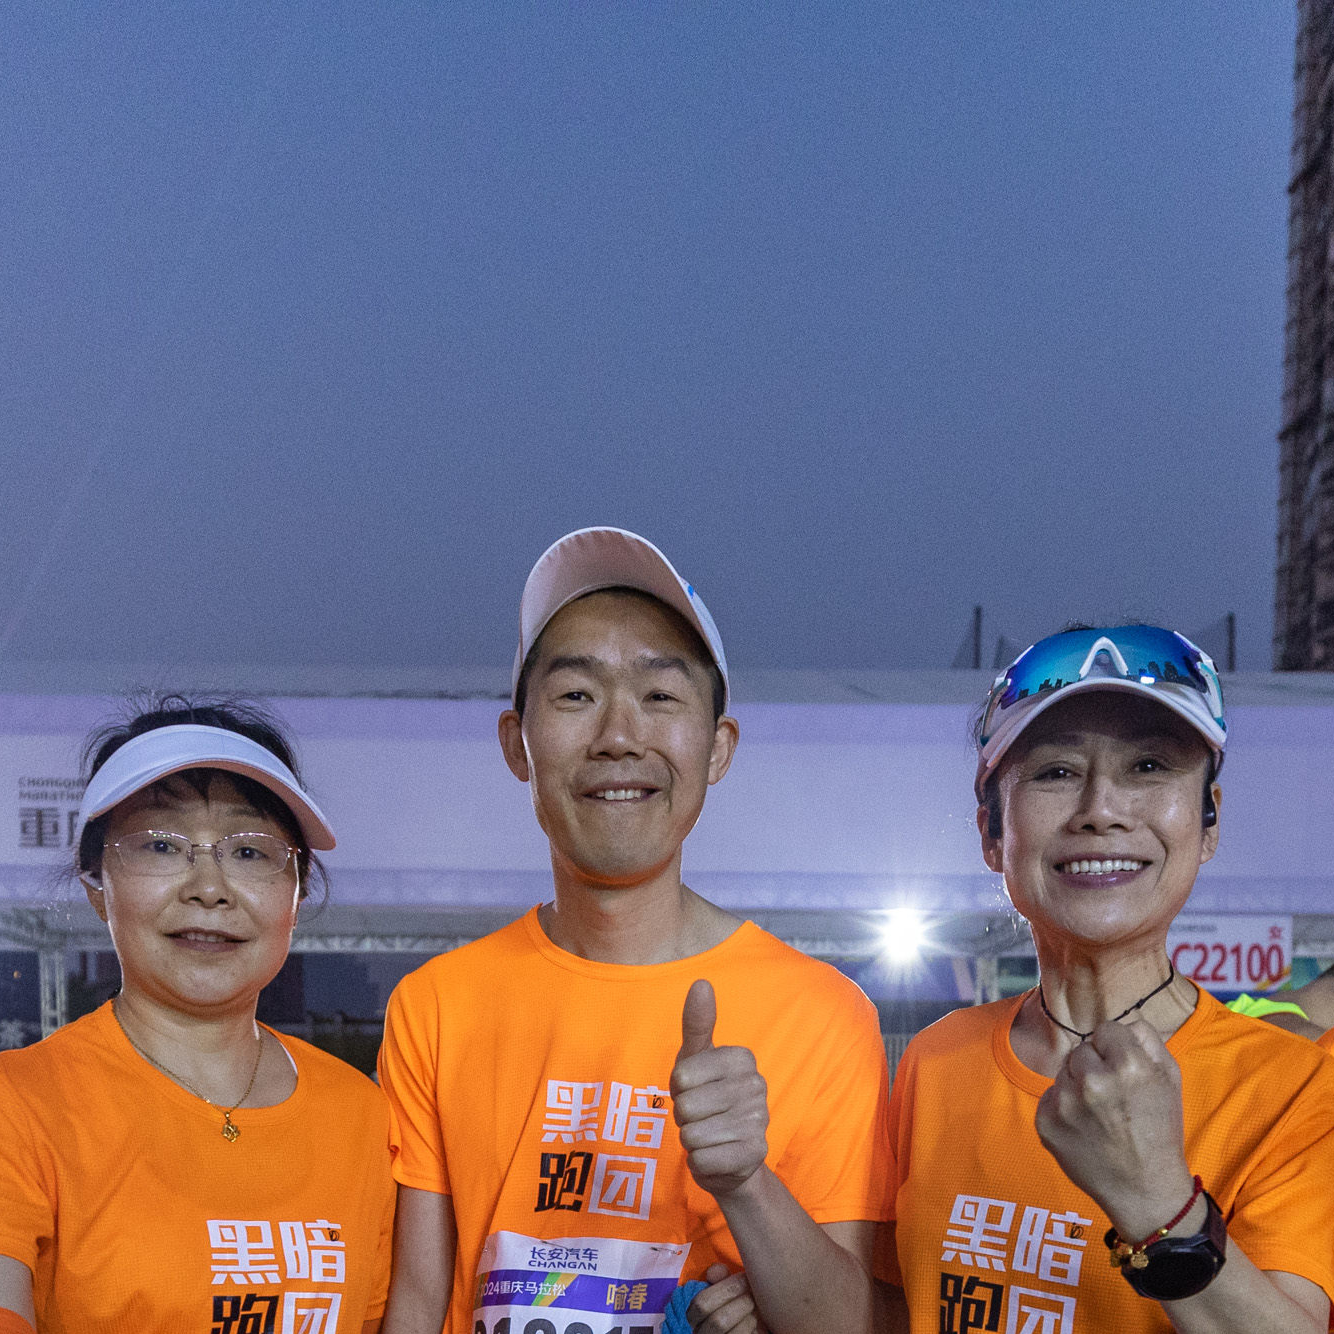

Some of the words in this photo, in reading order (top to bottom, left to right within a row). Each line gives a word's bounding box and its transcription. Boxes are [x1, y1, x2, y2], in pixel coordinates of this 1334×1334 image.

[18, 806, 81, 849] 重
[1172, 943, 1284, 982] C22100
[541, 1079, 671, 1149] 黑暗
[535, 1151, 658, 1220] 跑团
[207, 1219, 346, 1285] 黑暗
[529, 1247, 599, 1262] 长安汽车
[941, 1194, 1093, 1286] 黑暗
[528, 1259, 598, 1271] CHANGAN
[607, 1283, 648, 1311] 喻春
